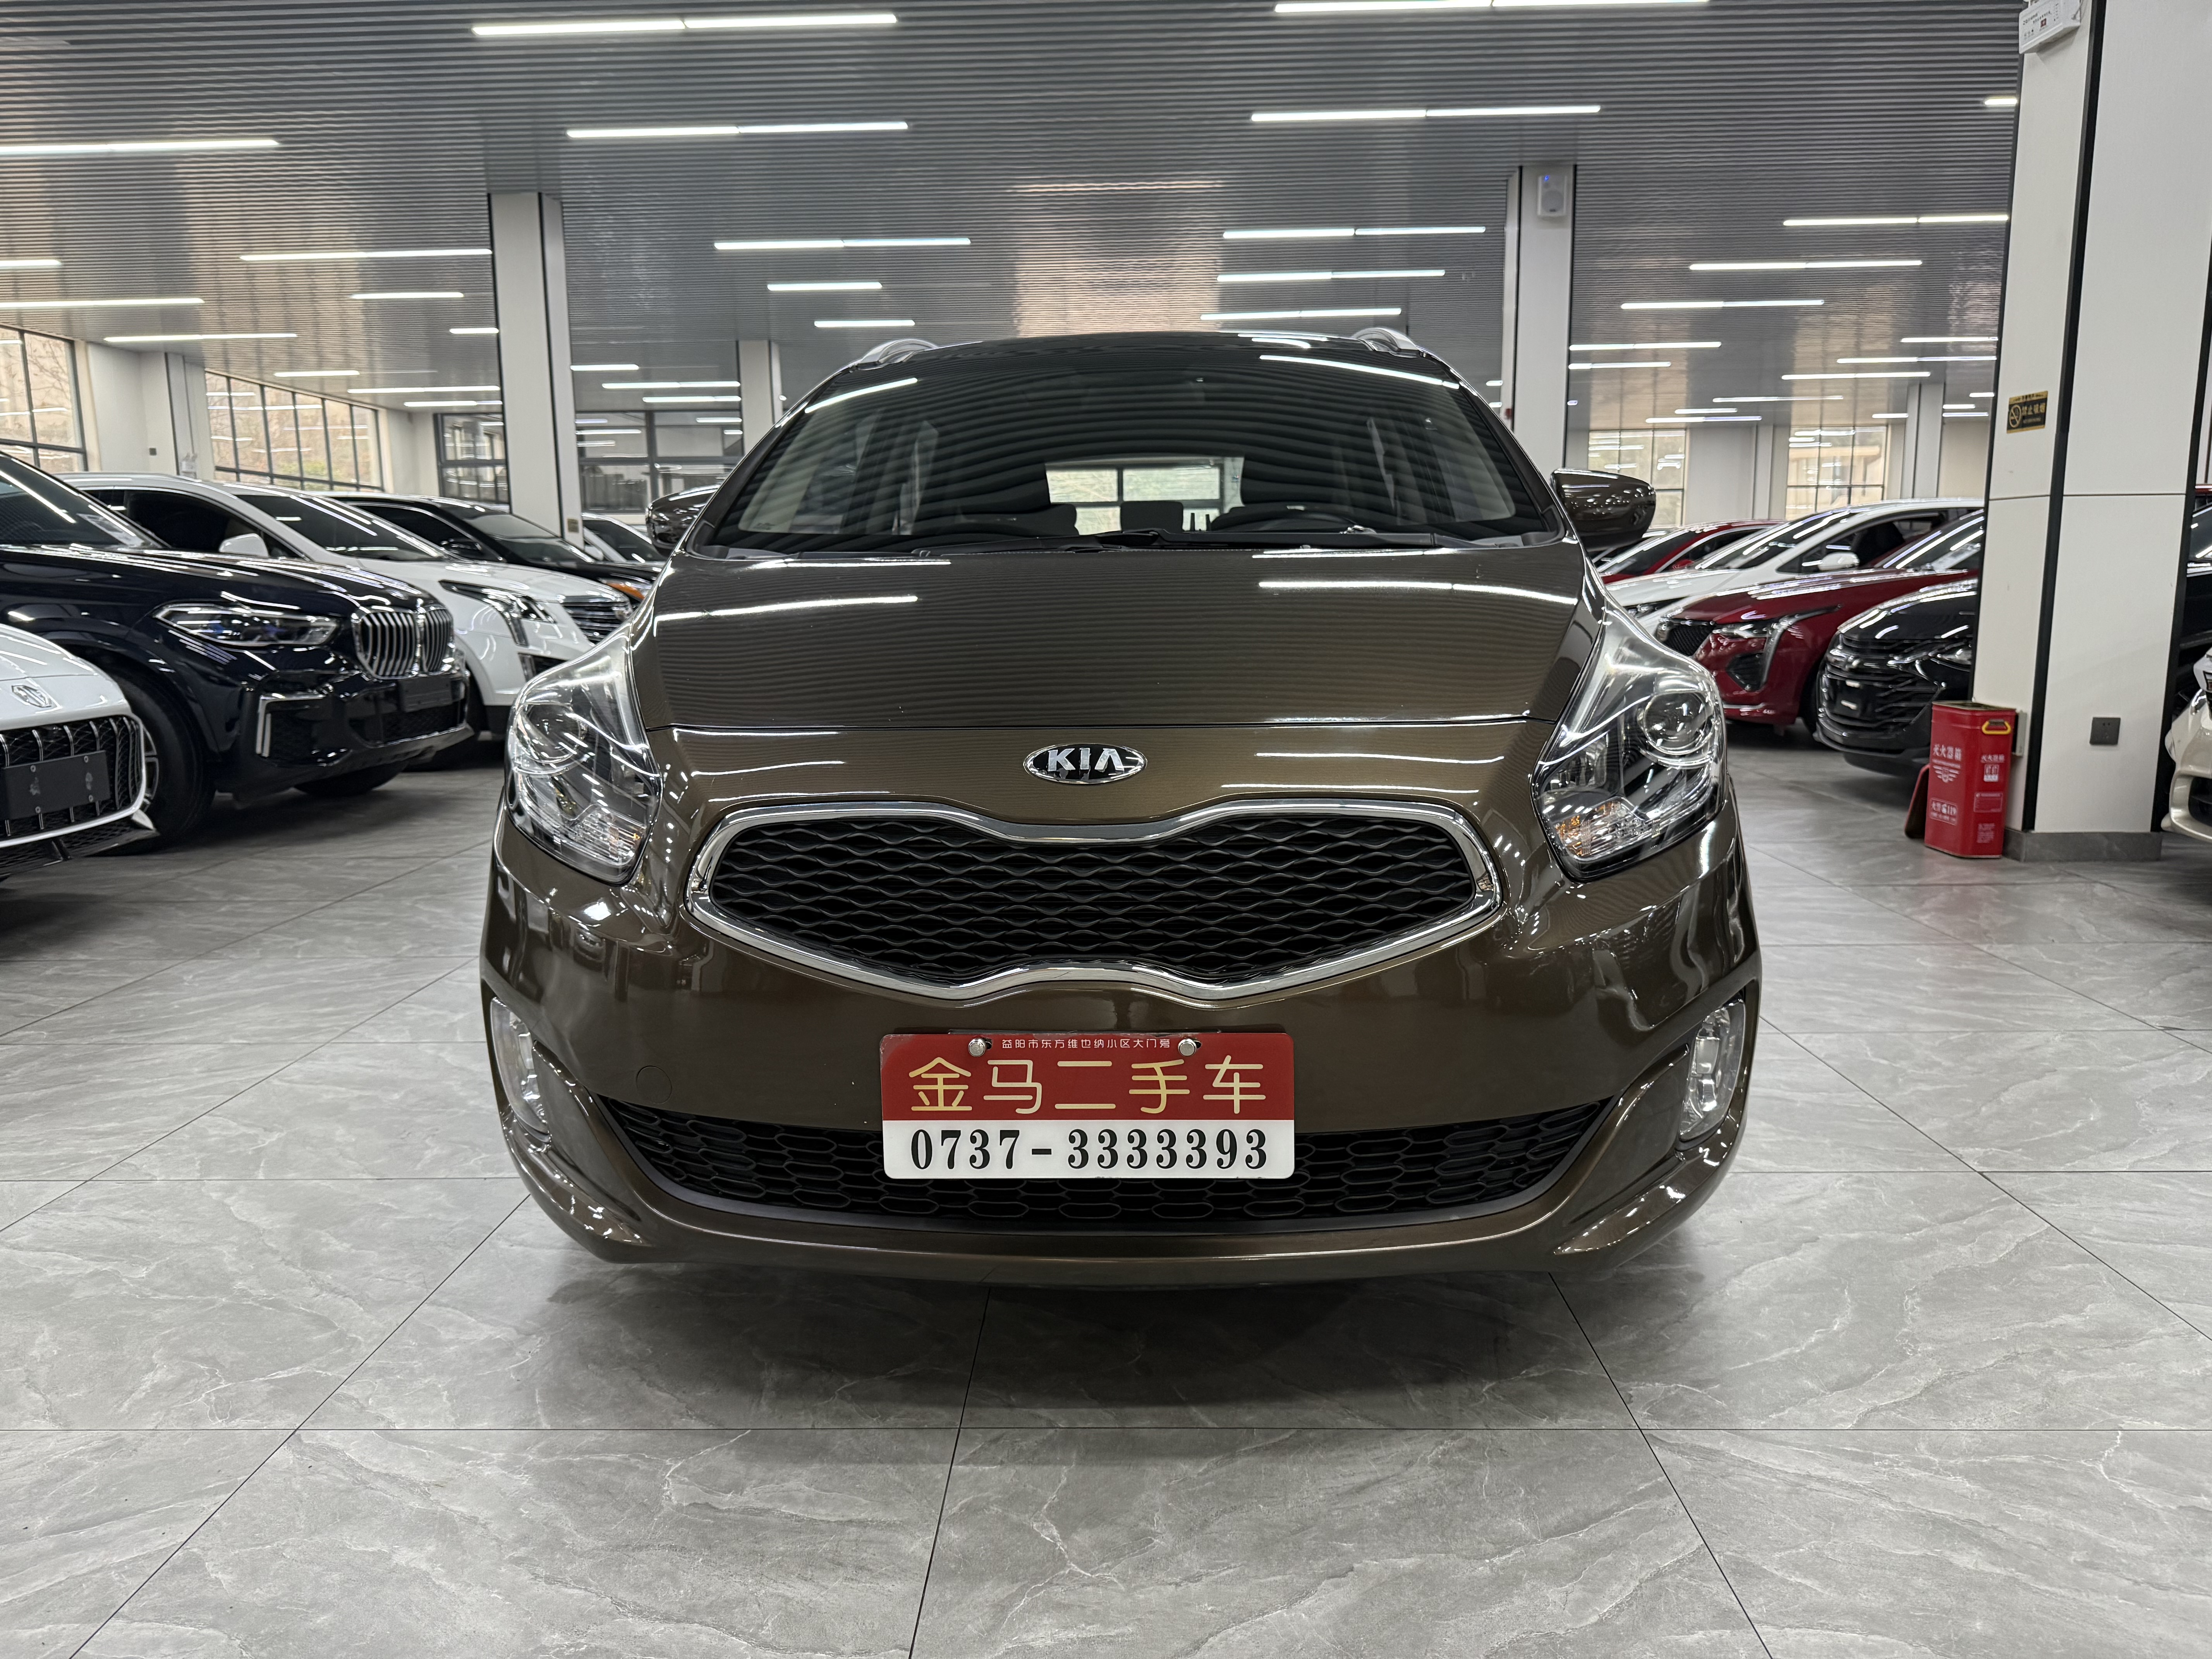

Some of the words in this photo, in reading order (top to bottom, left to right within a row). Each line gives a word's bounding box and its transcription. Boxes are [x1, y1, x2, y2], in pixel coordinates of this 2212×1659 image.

[1048, 748, 1124, 771] KIA
[1002, 1039, 1170, 1048] 益阳市东方维也纳小区大门旁
[908, 1055, 1266, 1114] 金马二手车
[911, 1129, 1267, 1170] 0737-3333393
